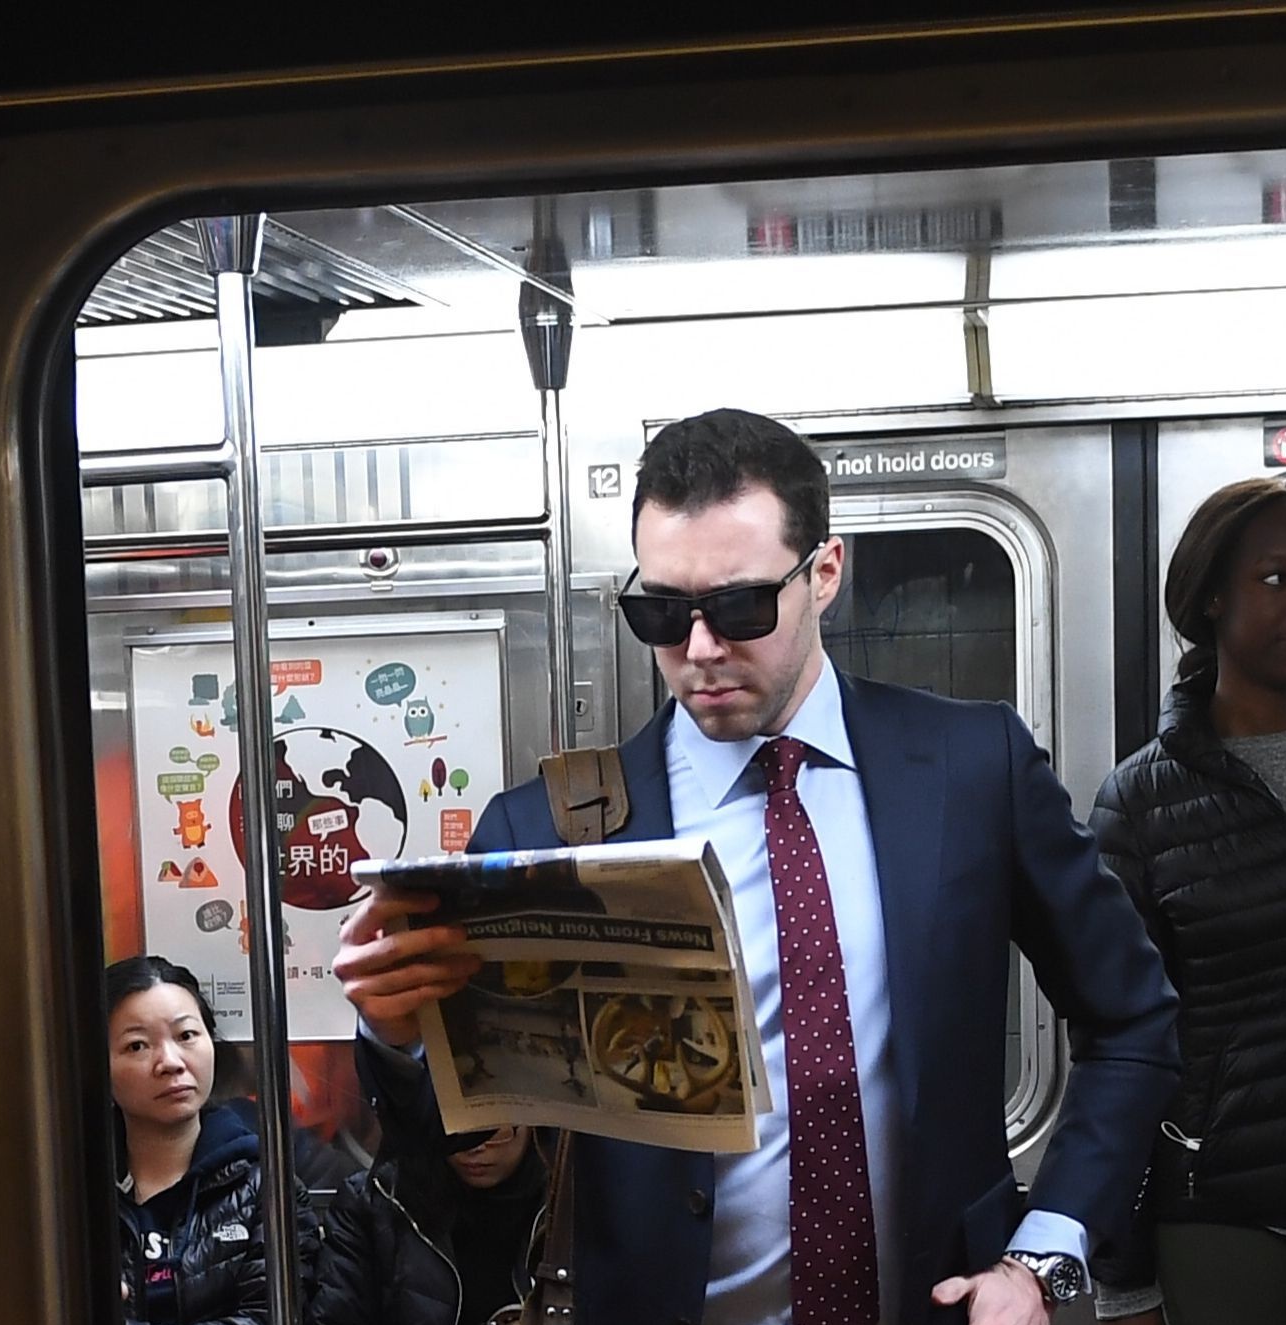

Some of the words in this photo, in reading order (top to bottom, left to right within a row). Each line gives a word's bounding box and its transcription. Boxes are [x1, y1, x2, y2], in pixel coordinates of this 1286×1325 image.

[836, 454, 873, 476] not
[877, 450, 926, 473] hold
[930, 450, 995, 470] doors
[591, 467, 619, 494] 12
[560, 922, 600, 938] Your
[604, 926, 652, 943] From
[657, 929, 708, 946] News
